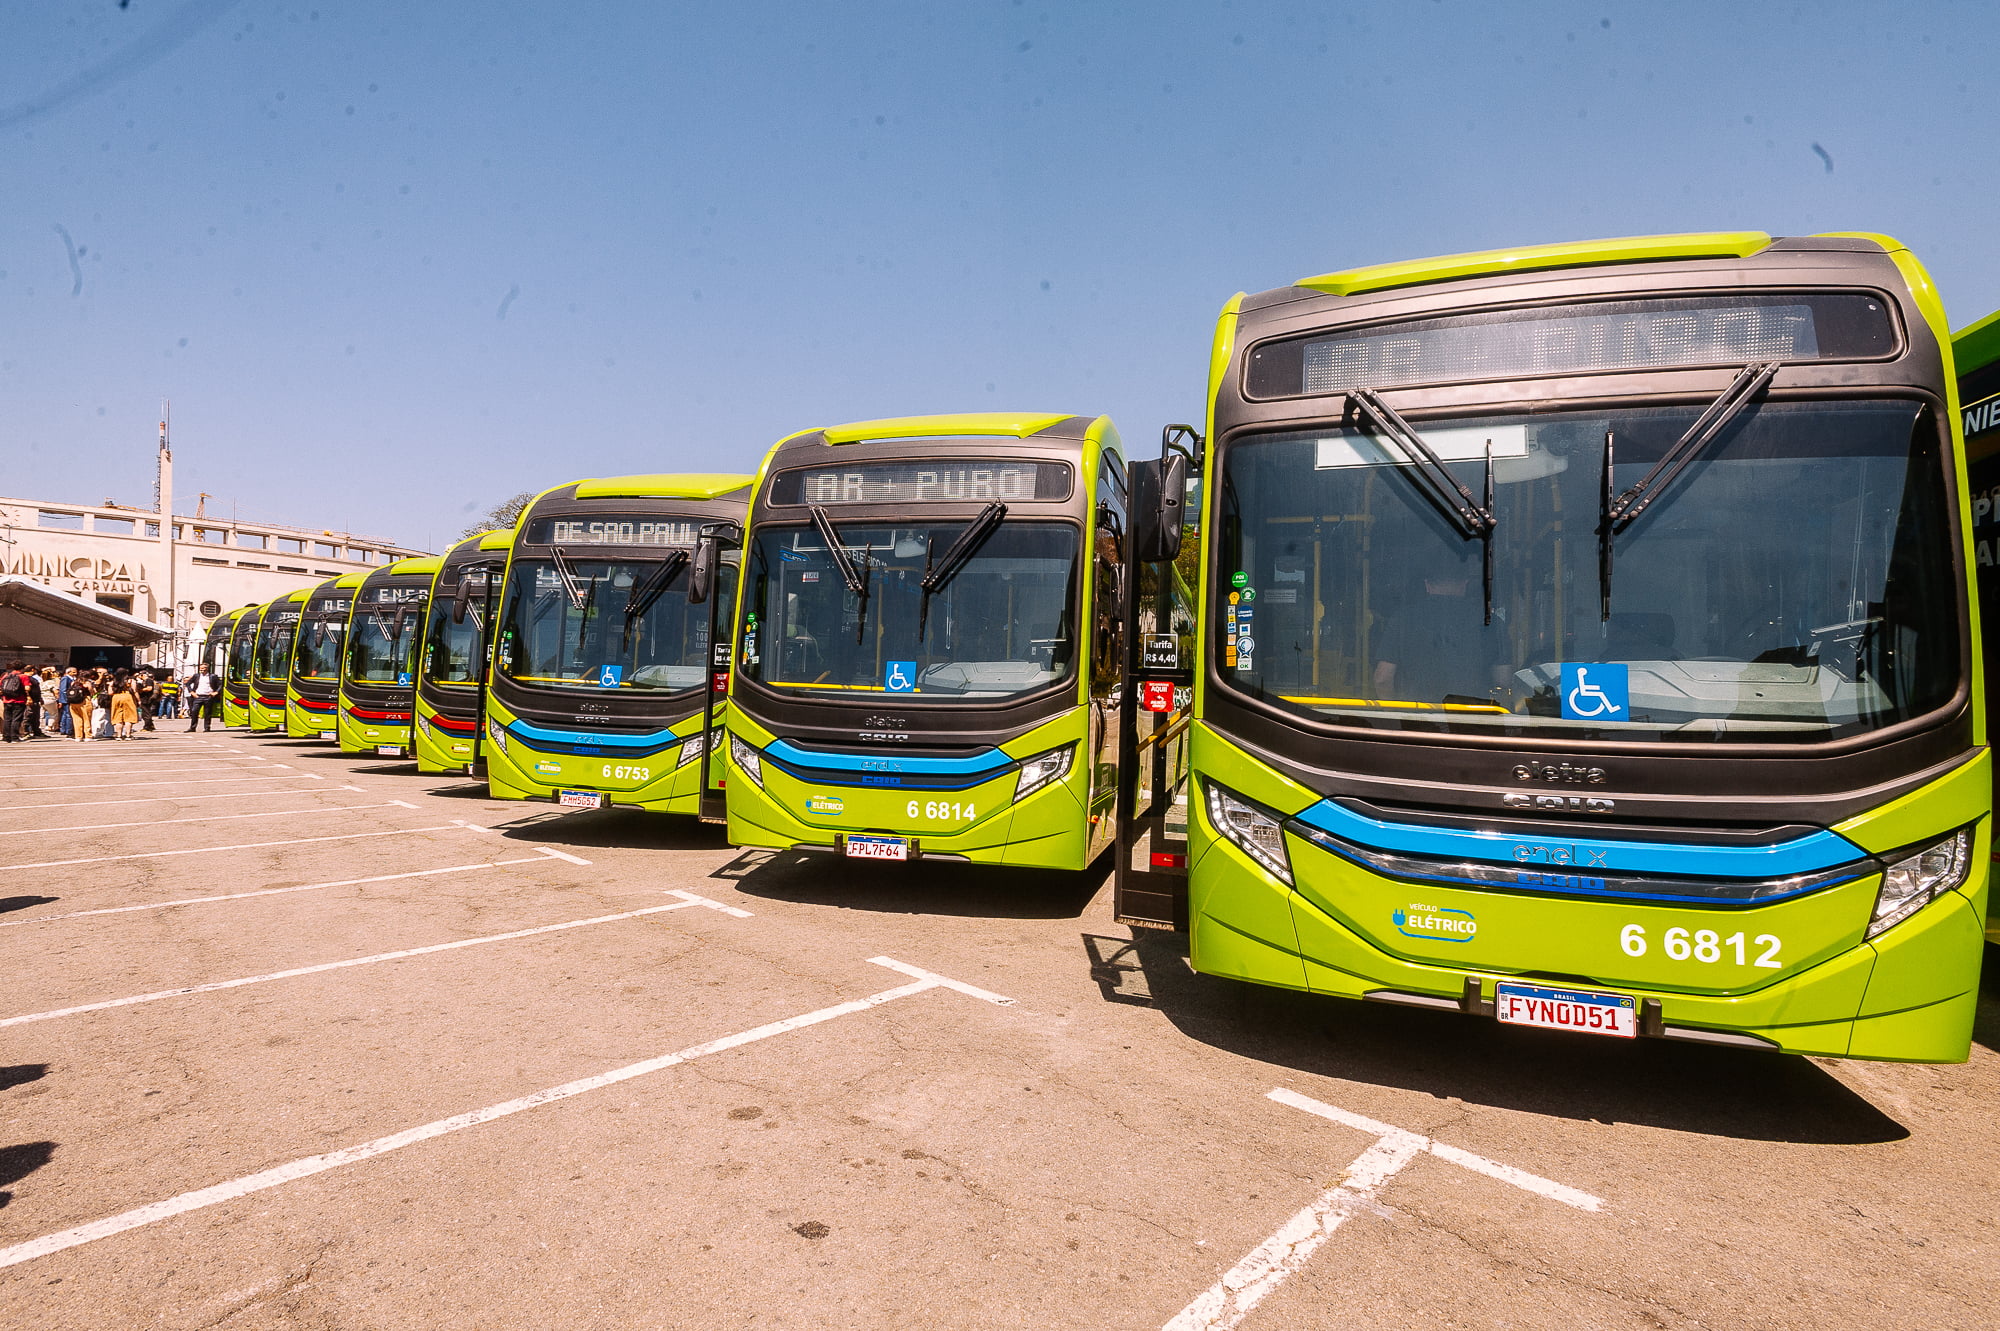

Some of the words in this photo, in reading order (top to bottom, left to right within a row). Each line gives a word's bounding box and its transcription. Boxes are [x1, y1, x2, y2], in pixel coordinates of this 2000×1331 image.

[817, 473, 864, 500] AR
[917, 469, 1021, 499] PURO
[554, 521, 583, 542] DE
[73, 580, 149, 594] CARVALHO
[1148, 640, 1173, 649] Tarifa
[1145, 653, 1157, 663] R$
[1158, 654, 1176, 664] 4,40
[602, 765, 611, 778] 6
[614, 765, 650, 780] 6753
[1512, 760, 1607, 784] eletra
[812, 800, 844, 811] ELÉTRICO
[906, 800, 919, 818] 6
[925, 801, 976, 821] 6814
[851, 842, 899, 857] FPL7F64
[1512, 843, 1578, 865] enel
[1588, 849, 1607, 867] x
[1409, 903, 1437, 912] VEÍCULO
[1408, 914, 1477, 934] ELÉTRICO
[1620, 923, 1648, 958] 6
[1663, 926, 1783, 969] 6812
[1553, 993, 1577, 1002] BRASIL
